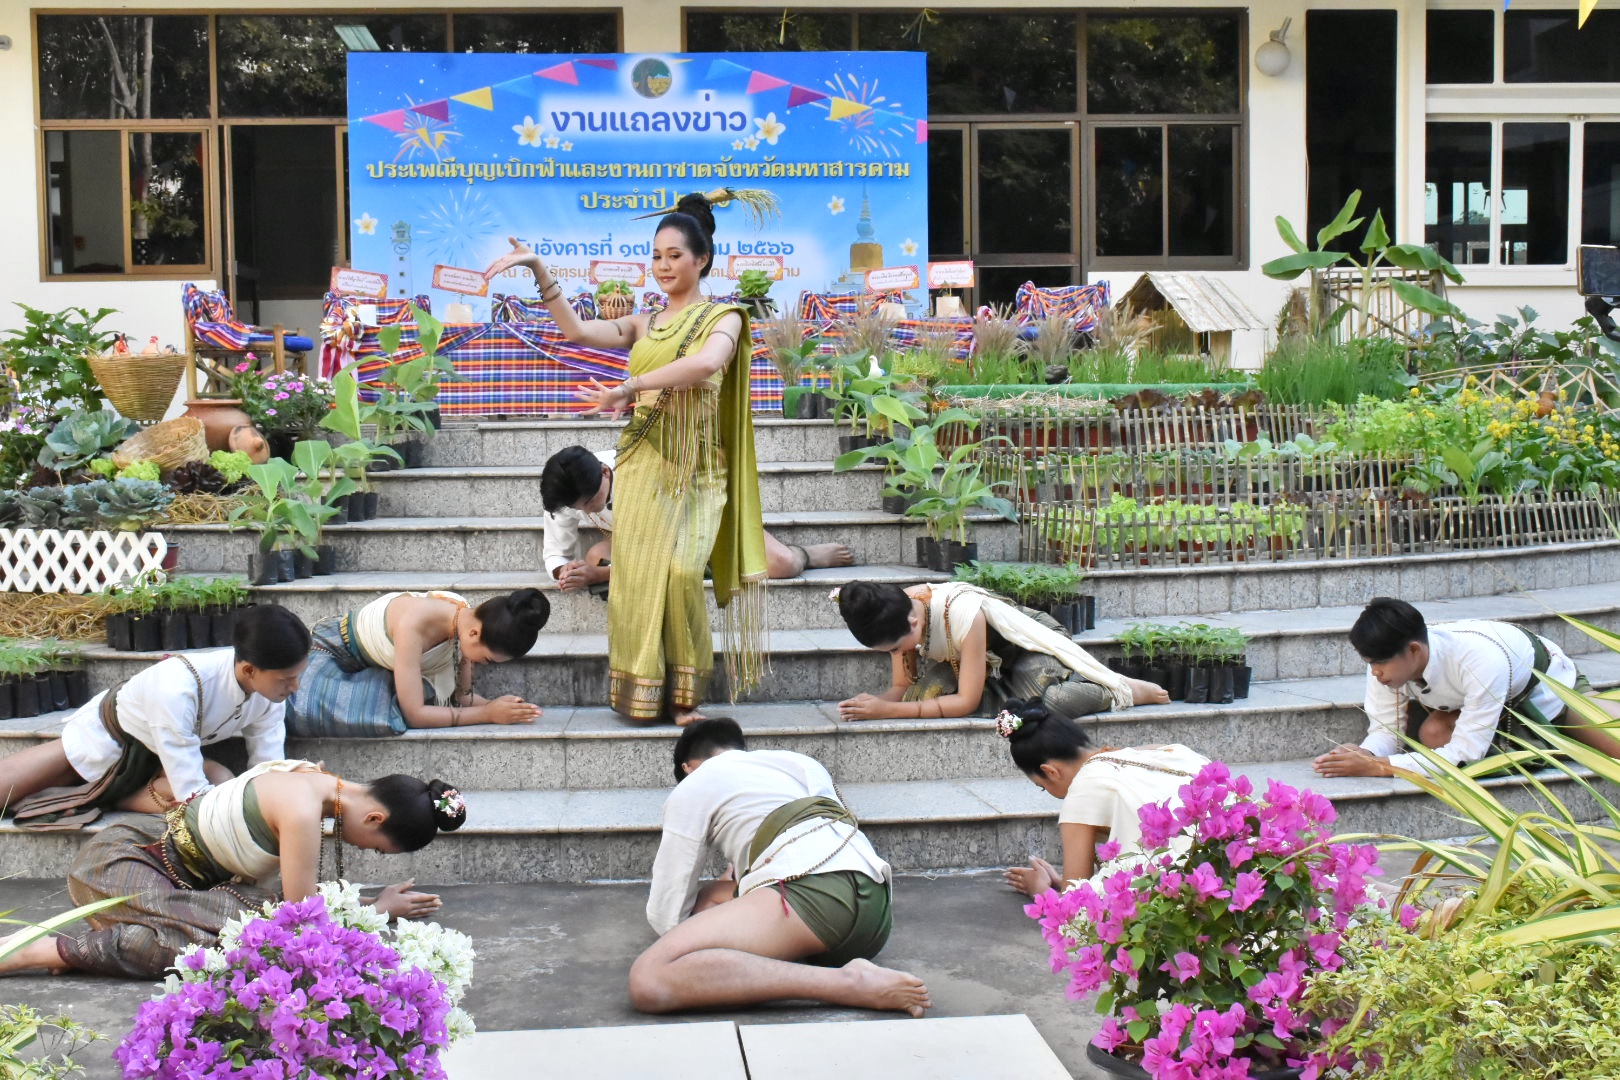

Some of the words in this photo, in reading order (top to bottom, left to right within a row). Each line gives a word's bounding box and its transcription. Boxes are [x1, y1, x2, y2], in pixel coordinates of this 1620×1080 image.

[551, 93, 747, 132] งานแถลงข่าว
[366, 155, 910, 184] ประเพณีบุญเบิกฟ้าและงานกาชาดจังหวัดมหาสารคาม
[580, 187, 667, 209] ประจำปี
[515, 233, 613, 256] ันอังคารที่
[619, 240, 651, 258] ๑๗
[737, 240, 795, 256] ๒๕๖๖
